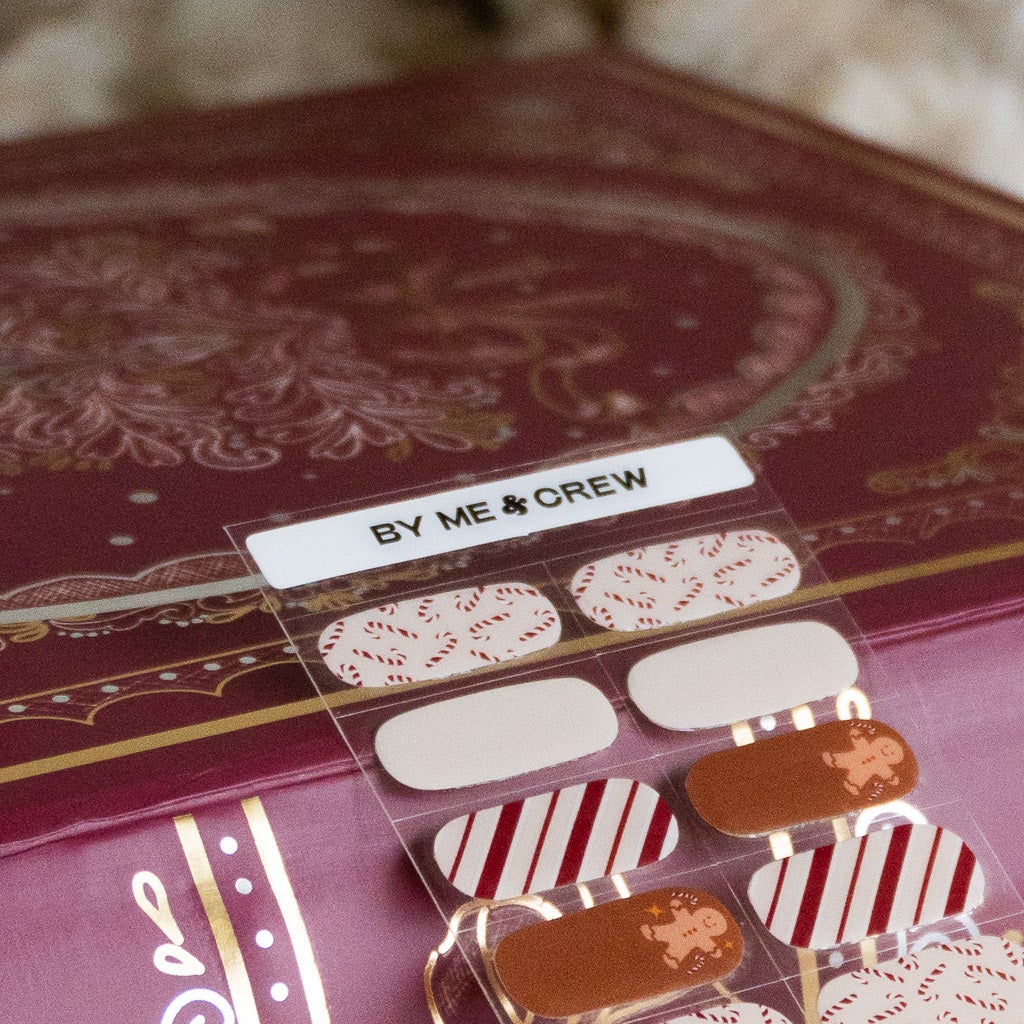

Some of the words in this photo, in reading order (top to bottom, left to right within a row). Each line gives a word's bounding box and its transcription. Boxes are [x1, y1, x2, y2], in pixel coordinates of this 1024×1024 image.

[370, 515, 423, 545] BY
[435, 501, 497, 531] ME
[501, 494, 529, 516] &
[533, 467, 648, 509] CREW
